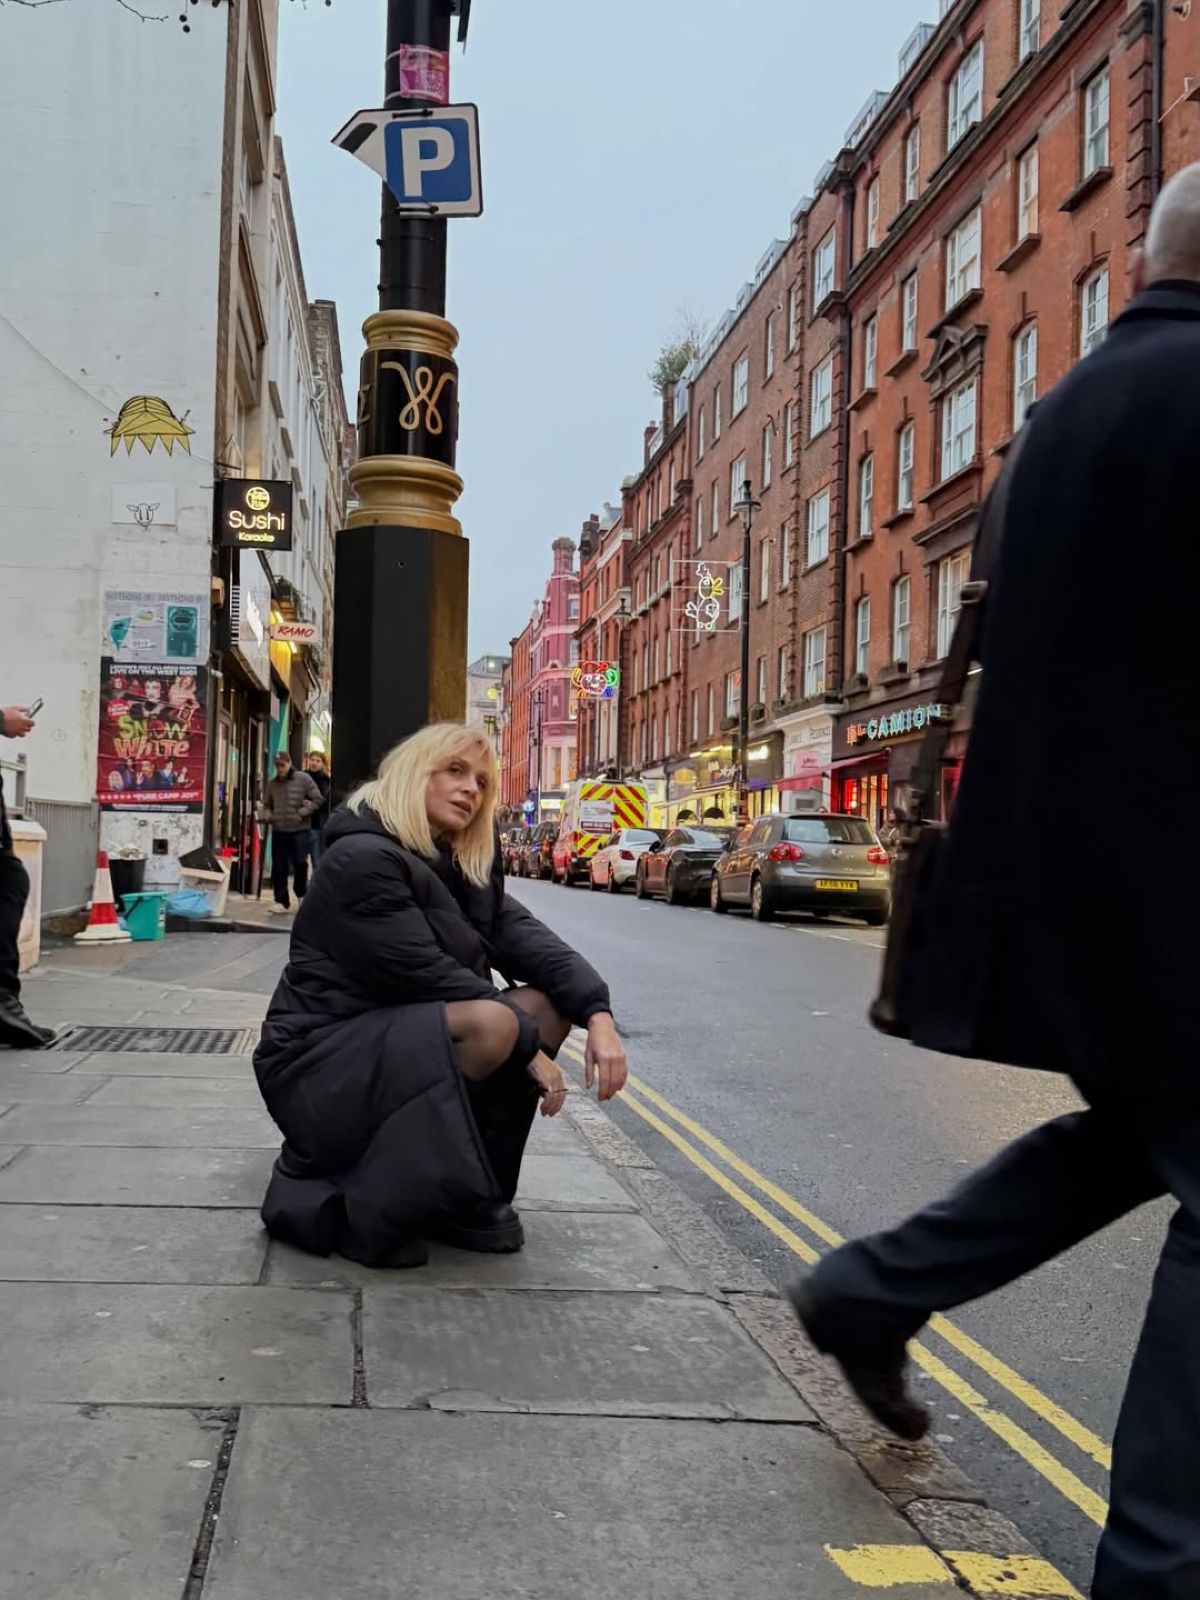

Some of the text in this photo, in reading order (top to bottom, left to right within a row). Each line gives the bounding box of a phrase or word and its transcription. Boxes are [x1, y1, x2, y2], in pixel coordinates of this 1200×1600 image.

[401, 126, 455, 197] P
[228, 510, 285, 531] Sushi
[277, 626, 314, 637] RAMO
[118, 715, 189, 740] SNOW
